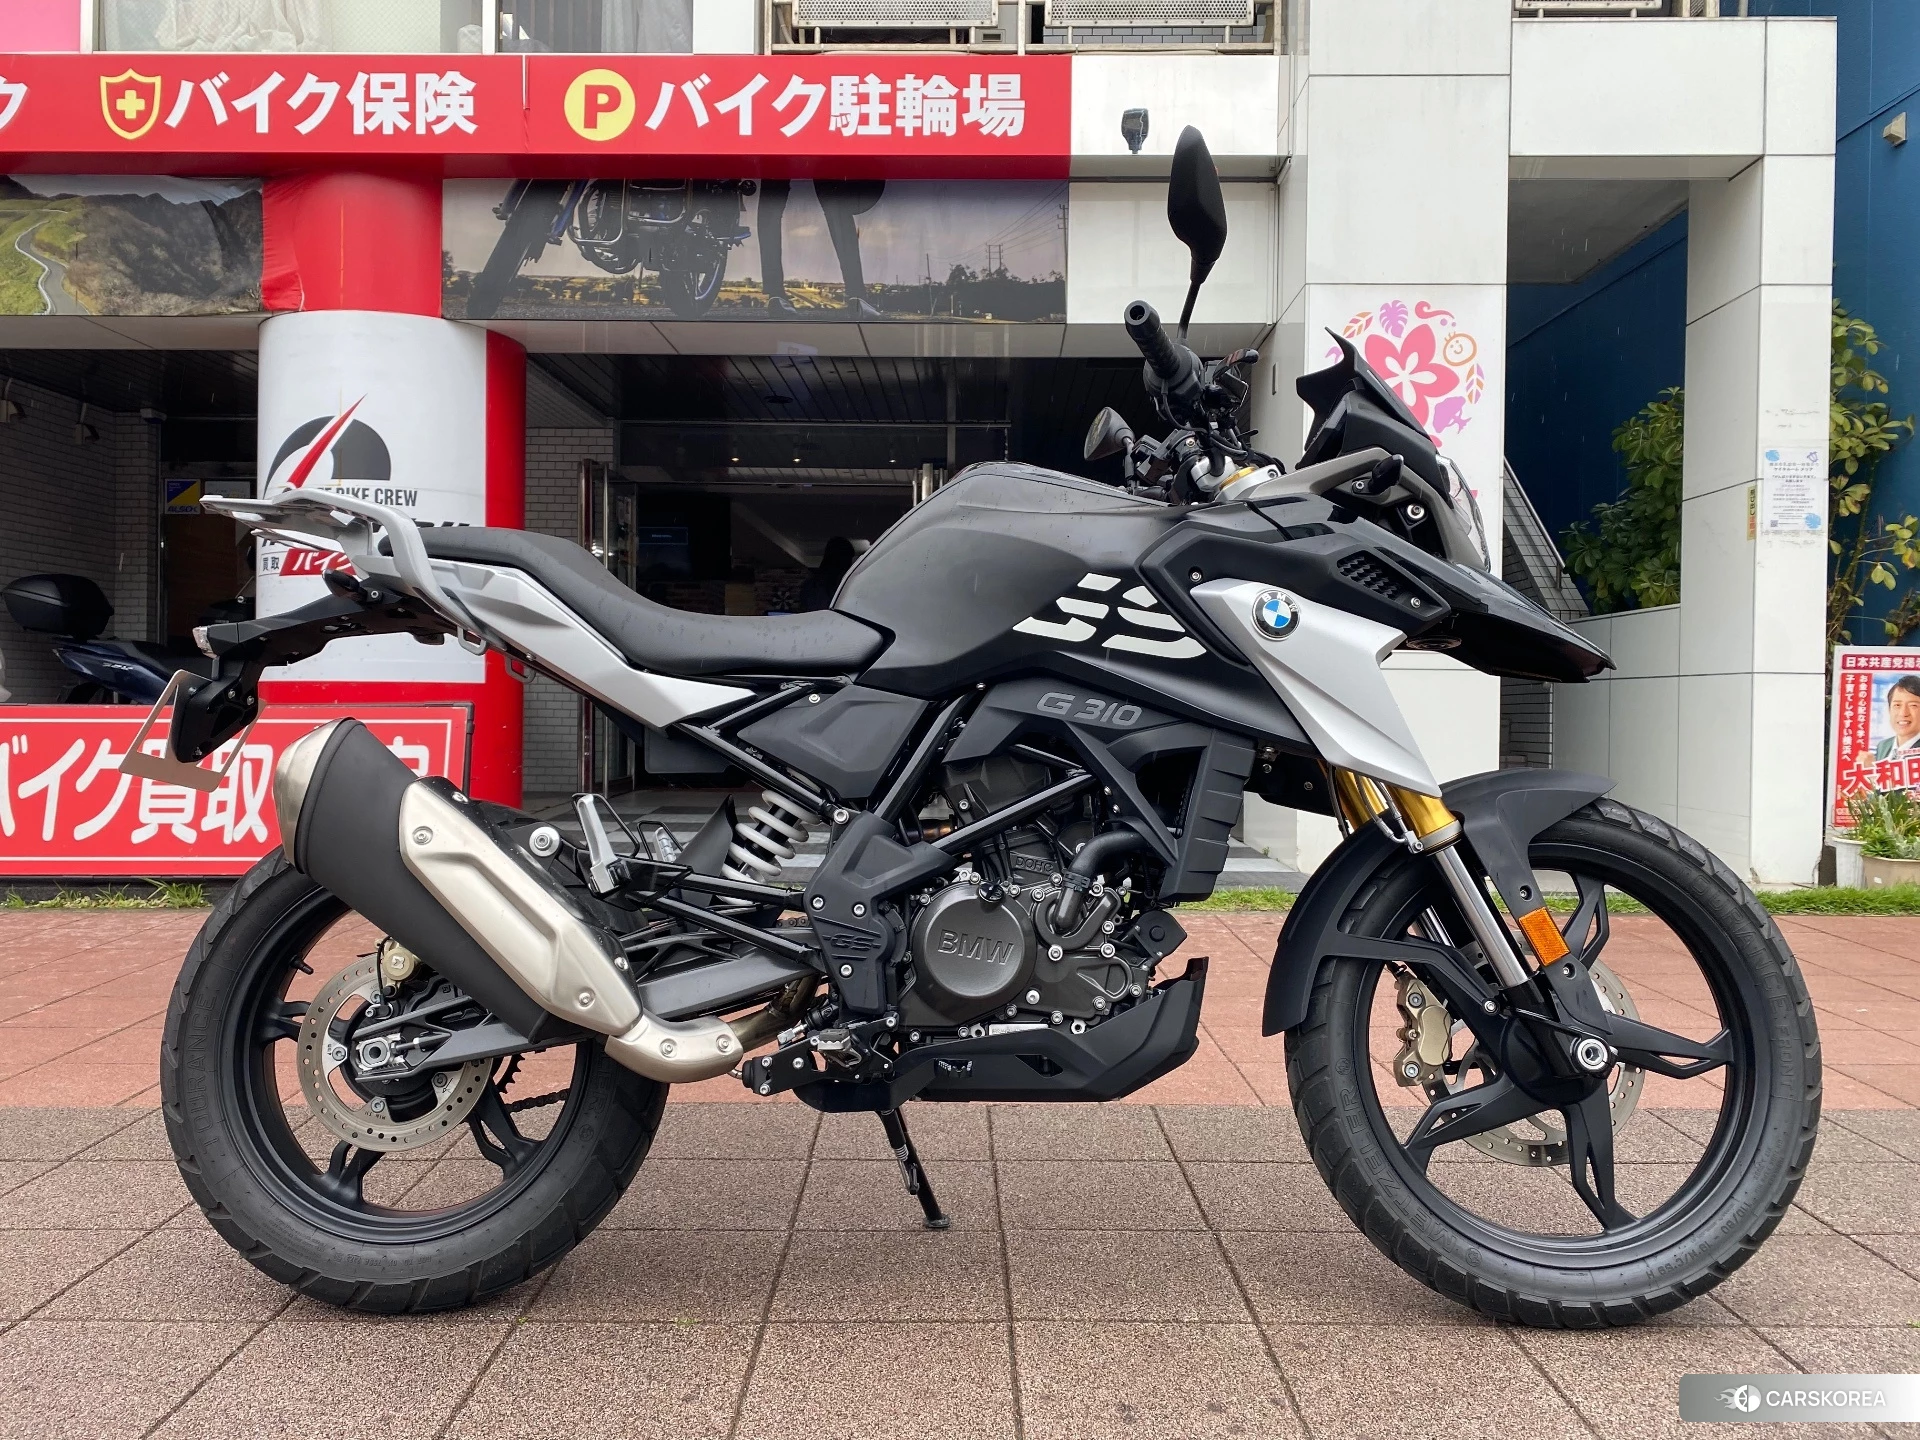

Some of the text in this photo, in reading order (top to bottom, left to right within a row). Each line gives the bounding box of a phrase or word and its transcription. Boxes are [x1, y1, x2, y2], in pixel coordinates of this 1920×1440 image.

[165, 71, 477, 135] バイク保険
[645, 73, 1026, 137] バイク駐輪場
[374, 489, 417, 507] CREW
[1037, 692, 1142, 726] G 310
[937, 928, 1014, 966] BMW
[188, 997, 220, 1152] TOURANCE
[1340, 1088, 1458, 1249] METZELER
